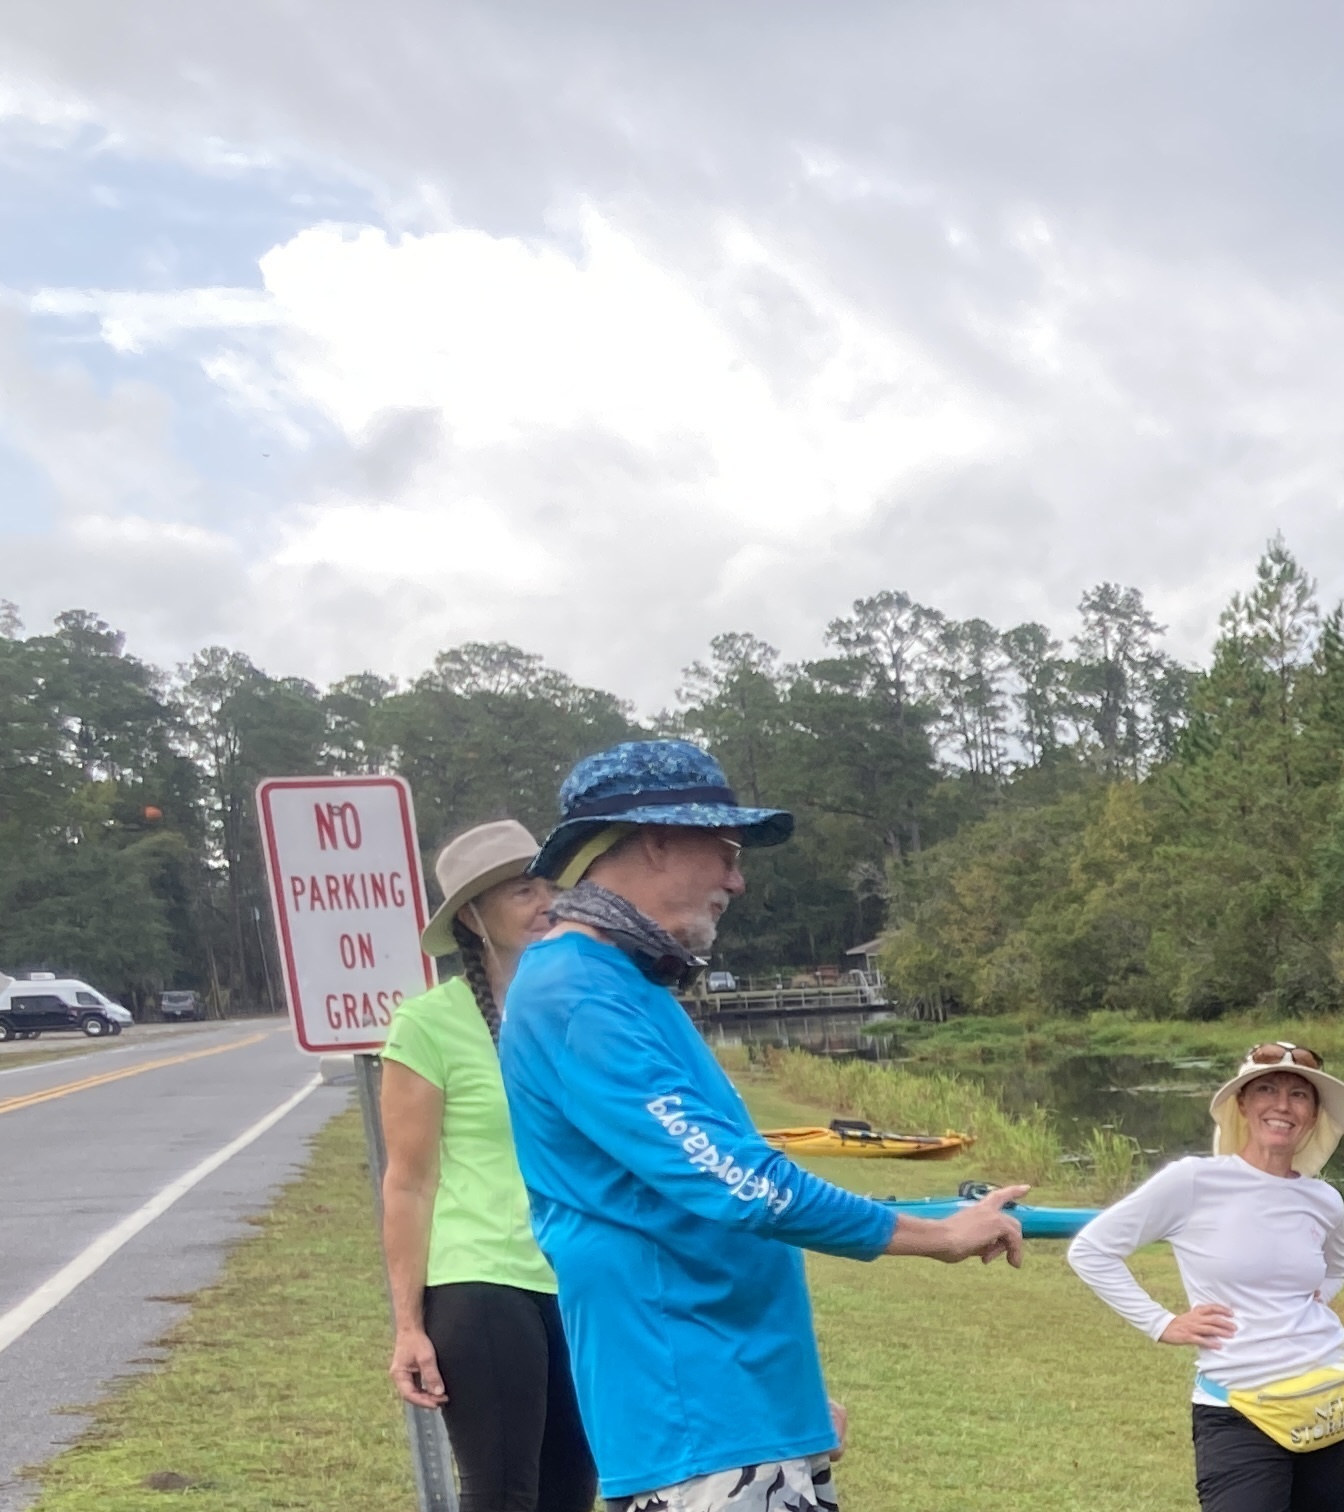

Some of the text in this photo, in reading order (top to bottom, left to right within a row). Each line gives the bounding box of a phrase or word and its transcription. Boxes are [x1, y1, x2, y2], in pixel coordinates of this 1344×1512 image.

[314, 802, 362, 851] NO
[290, 871, 406, 912] PARKING
[339, 932, 375, 969] ON
